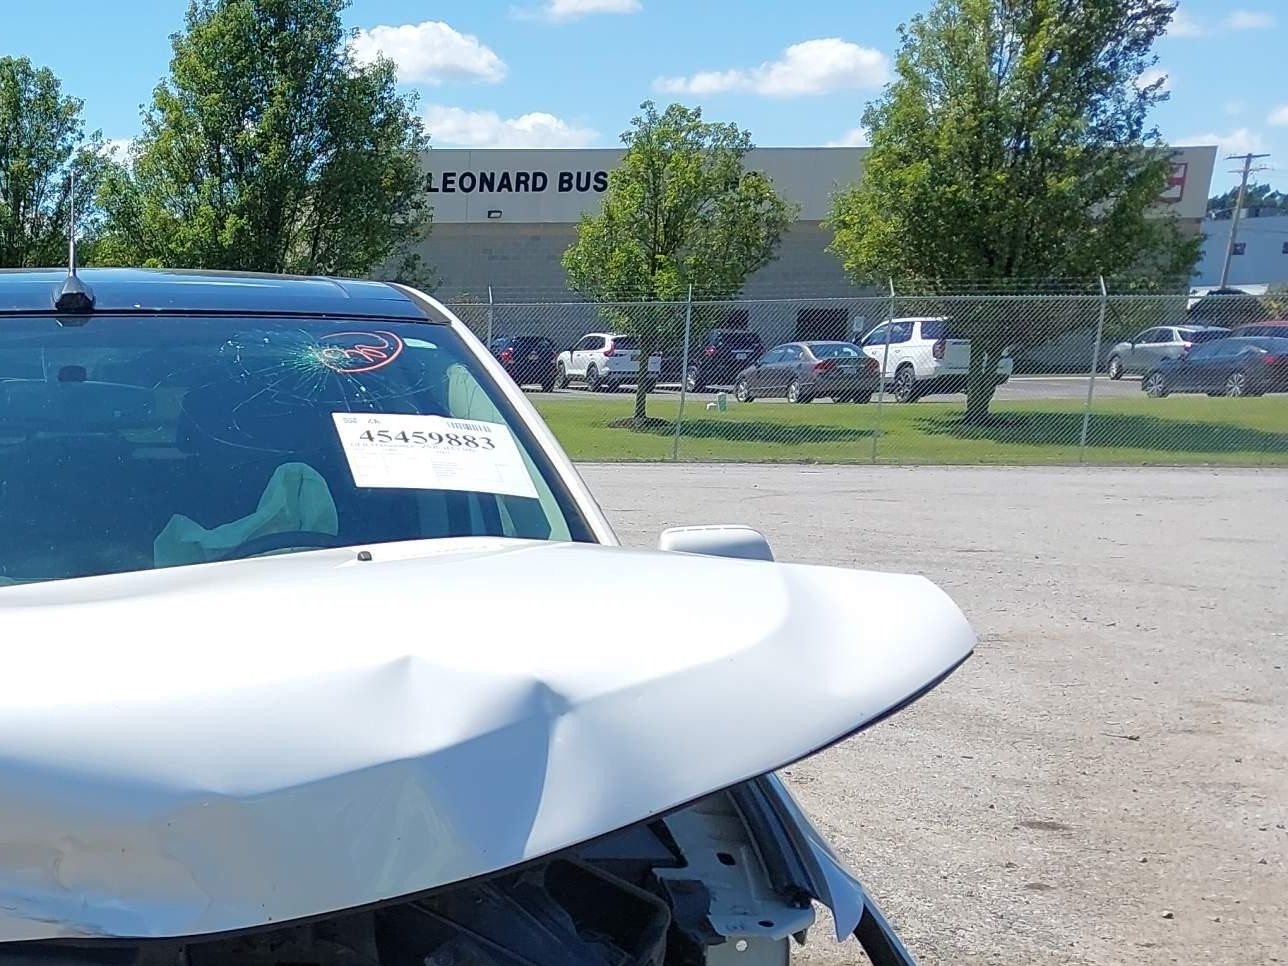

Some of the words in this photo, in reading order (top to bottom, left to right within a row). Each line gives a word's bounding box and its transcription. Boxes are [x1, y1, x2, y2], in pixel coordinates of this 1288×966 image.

[425, 171, 548, 193] LEONARD
[558, 171, 608, 193] BUS
[359, 429, 496, 450] 45459883
